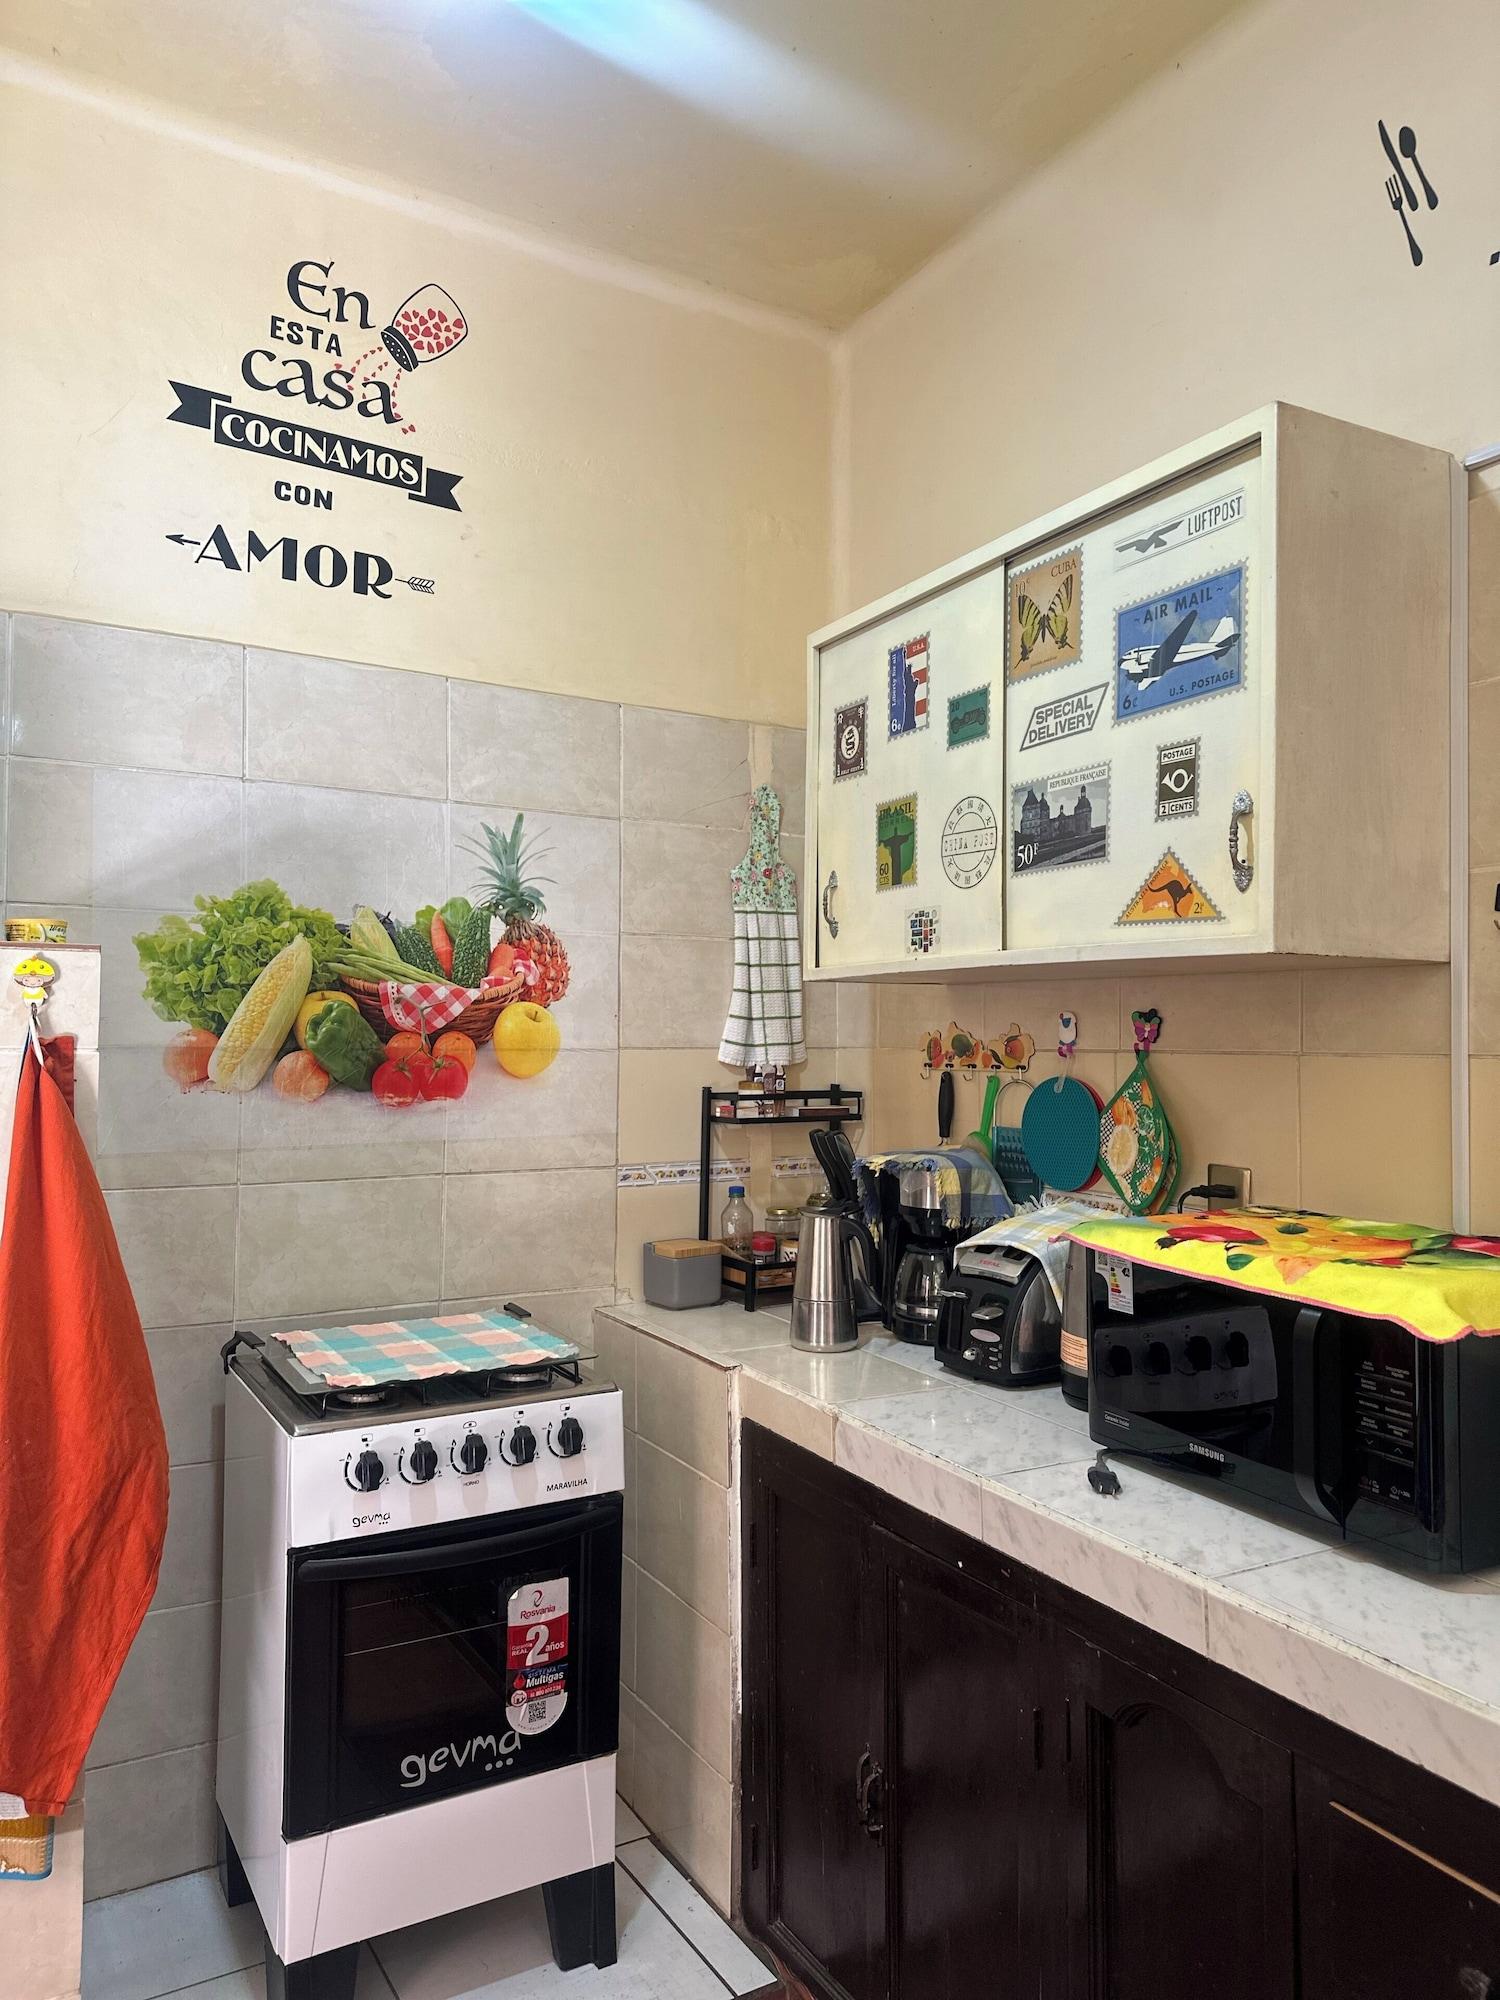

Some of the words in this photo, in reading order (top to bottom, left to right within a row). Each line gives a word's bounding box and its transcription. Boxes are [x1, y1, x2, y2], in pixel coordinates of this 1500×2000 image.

[287, 260, 376, 329] En
[270, 315, 342, 357] ESTA
[221, 413, 420, 485] COCINAMOS
[274, 480, 333, 511] CON
[1187, 495, 1243, 536] LUFTPOST
[195, 524, 393, 599] AMOR
[1050, 558, 1077, 578] CUBA
[1143, 604, 1168, 625] AIR
[1174, 587, 1213, 613] MAIL
[1169, 686, 1188, 698] U.S.
[1191, 669, 1236, 690] POSTAGE
[1035, 694, 1094, 725] SPECIAL
[1028, 709, 1095, 744] DELIVERY
[1162, 746, 1194, 761] POSTAGE
[879, 801, 914, 820] BRASIL
[1161, 804, 1167, 815] 2
[1170, 801, 1193, 813] CENTS
[944, 837, 969, 853] CHINA
[973, 831, 995, 848] POST
[879, 862, 889, 877] 60
[1125, 887, 1149, 920] AUSTRALIA
[1149, 859, 1170, 886] POSTAGE
[1189, 1442, 1225, 1463] SAMSUNG
[546, 1478, 588, 1492] MARAVILHA
[520, 1605, 556, 1619] Rosvania
[511, 1648, 529, 1657] REAL
[525, 1624, 549, 1667] 2
[545, 1641, 565, 1652] años
[526, 1672, 564, 1688] Multigas
[400, 1730, 521, 1788] gevma
